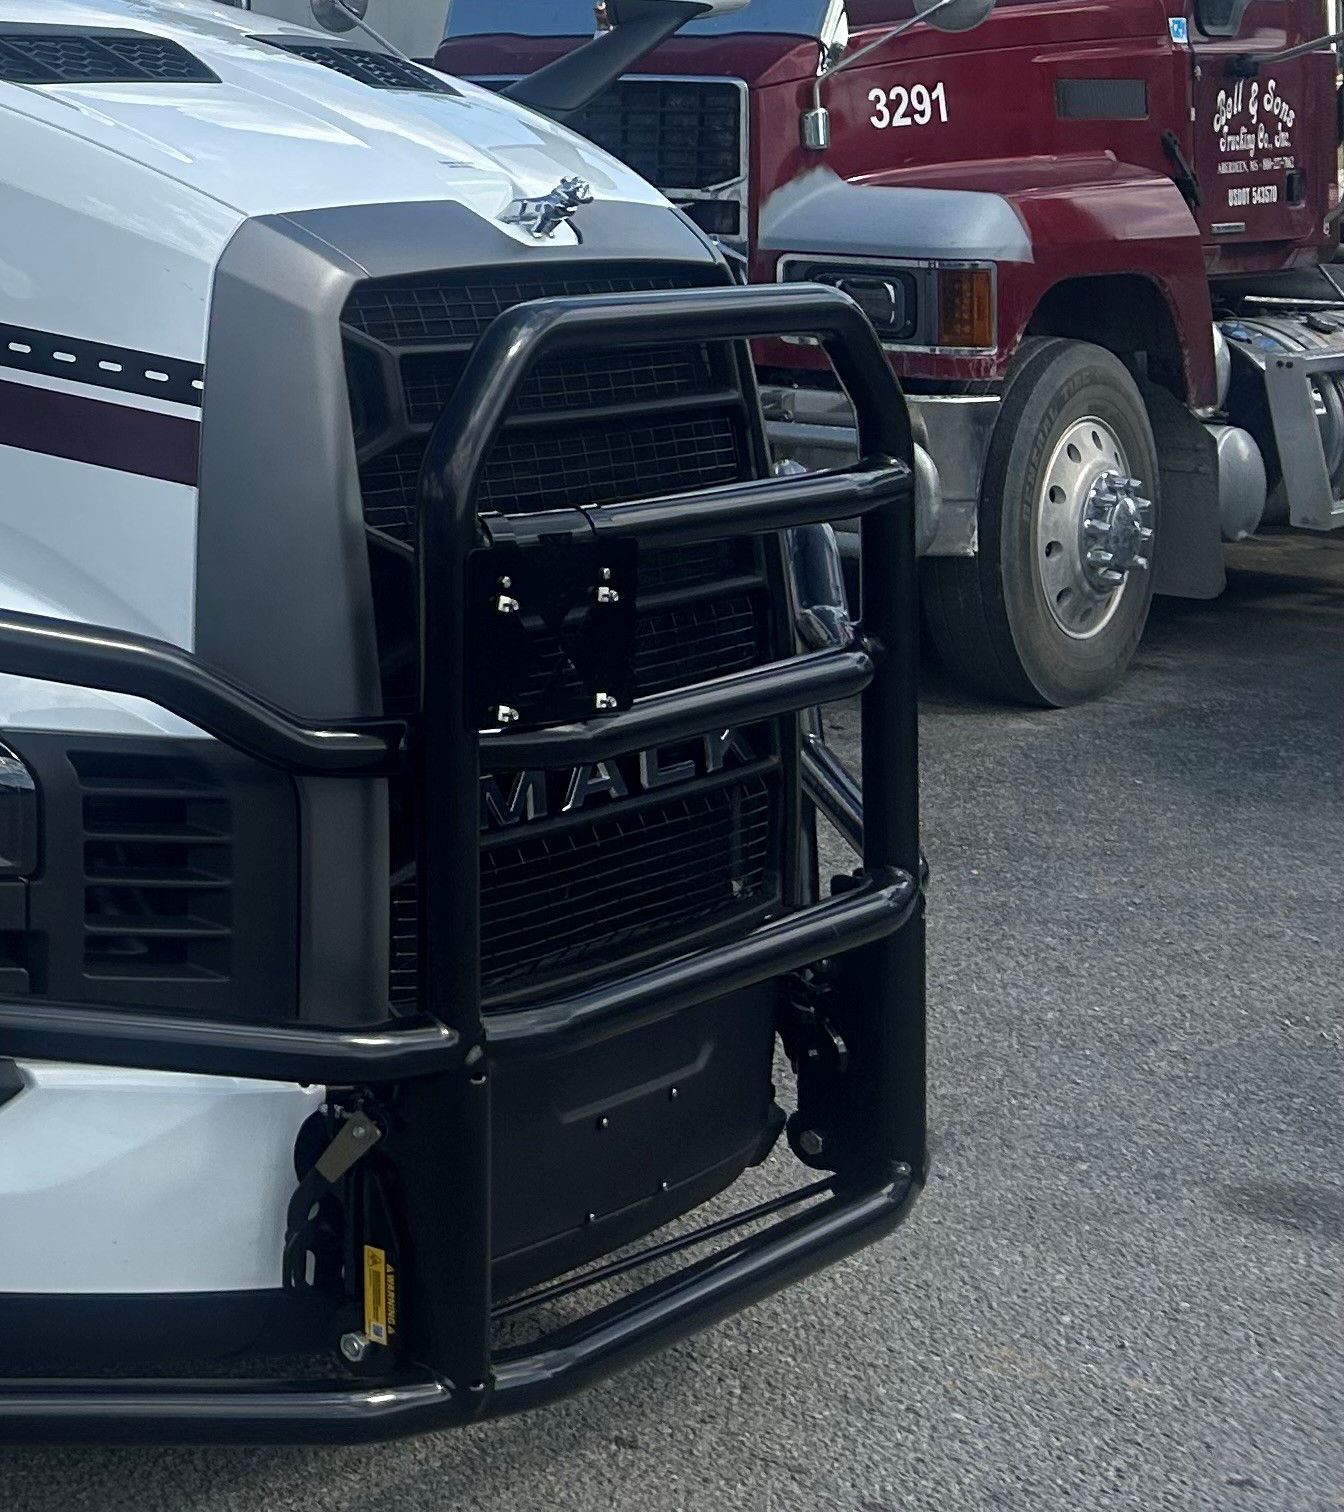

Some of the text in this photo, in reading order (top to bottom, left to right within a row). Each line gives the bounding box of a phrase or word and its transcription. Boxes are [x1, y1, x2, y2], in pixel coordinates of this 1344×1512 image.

[867, 81, 949, 129] 3291
[1213, 78, 1296, 133] Bell & Sons
[385, 1273, 396, 1326] WARNING
